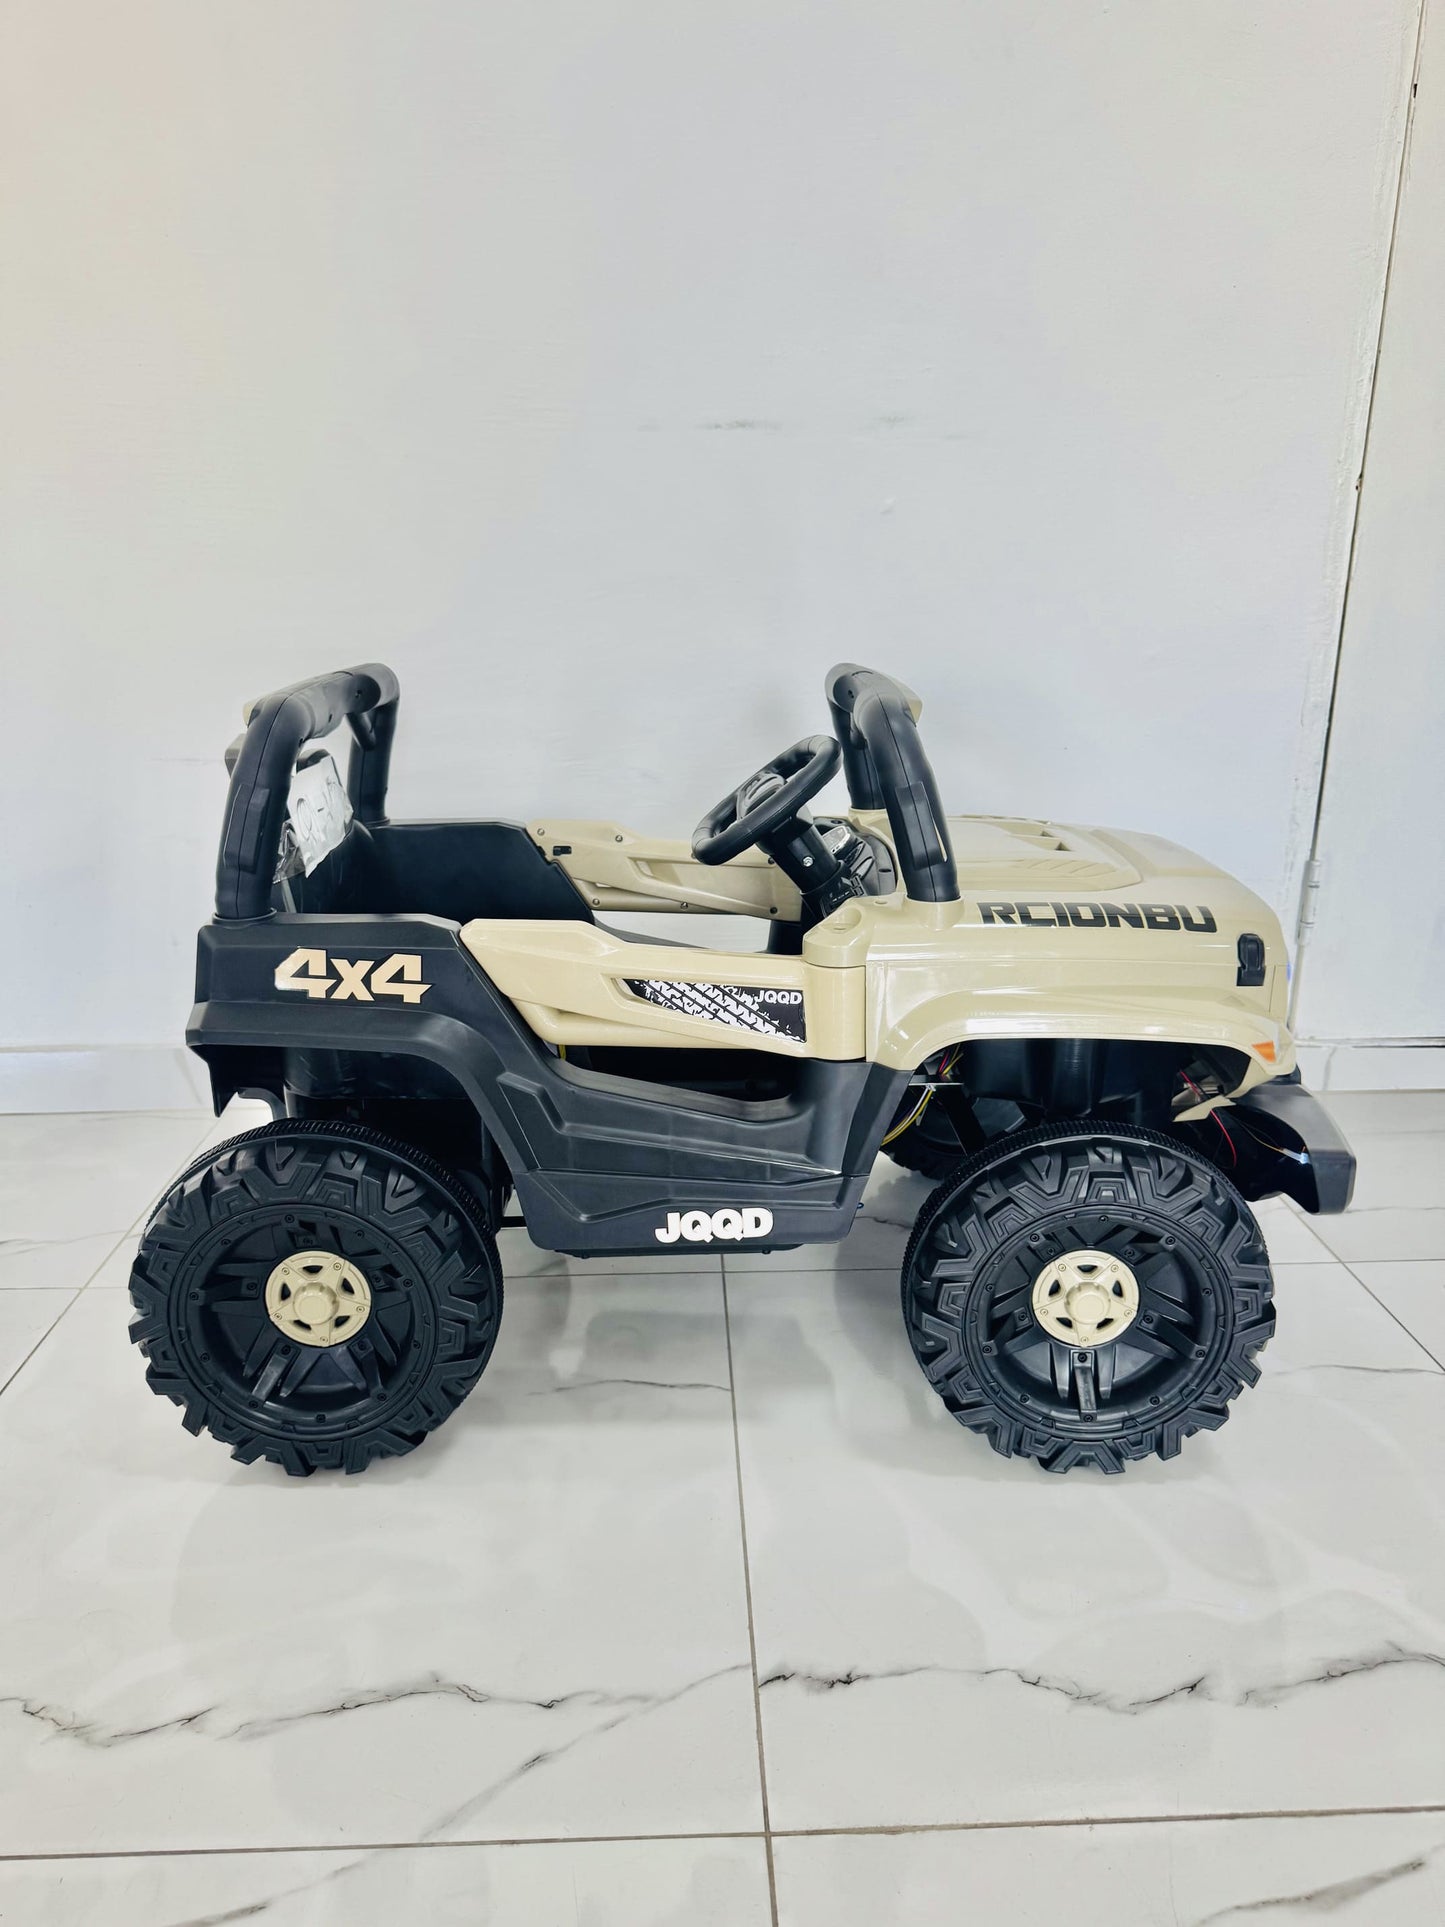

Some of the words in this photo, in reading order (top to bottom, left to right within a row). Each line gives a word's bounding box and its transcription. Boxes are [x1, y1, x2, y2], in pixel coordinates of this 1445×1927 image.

[977, 902, 1217, 932] RCIONBU
[754, 990, 803, 1005] JQQD
[654, 1207, 774, 1243] JQQD
